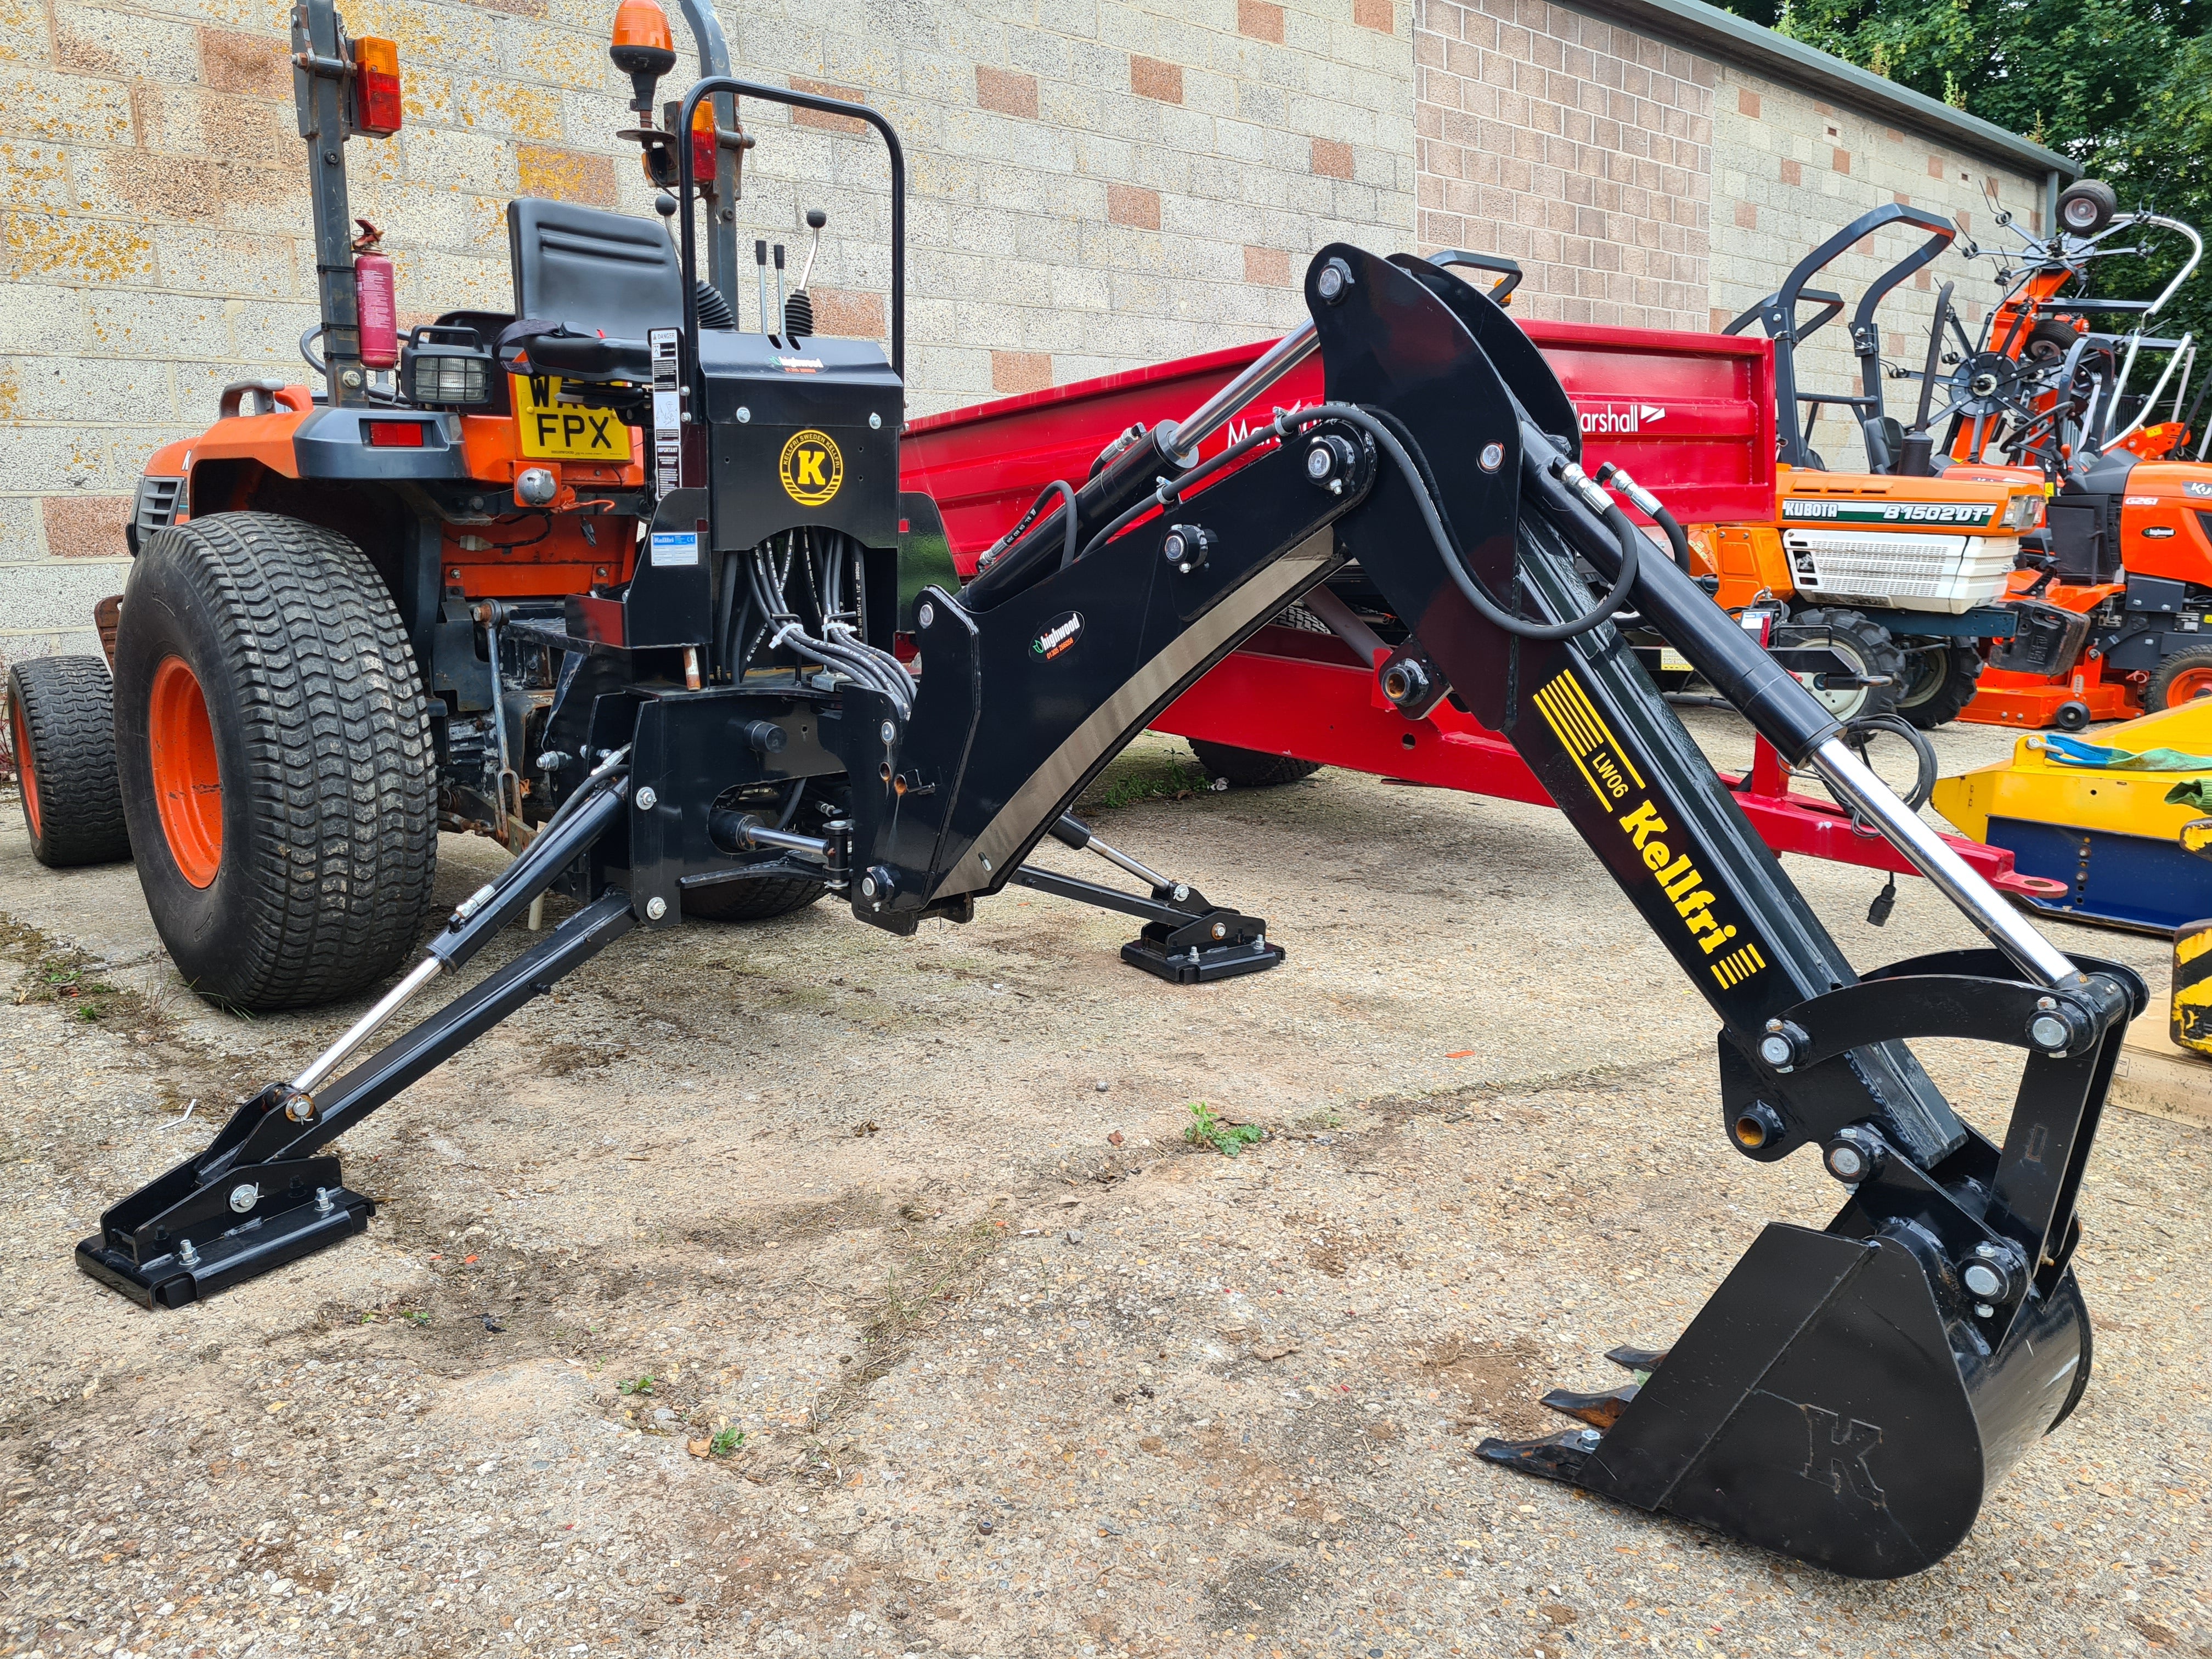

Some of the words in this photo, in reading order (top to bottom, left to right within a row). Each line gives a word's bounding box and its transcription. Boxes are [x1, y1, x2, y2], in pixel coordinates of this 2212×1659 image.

[537, 413, 612, 449] FPX
[1573, 403, 1639, 432] arshall
[783, 439, 799, 465] KELLFRI
[799, 433, 826, 442] SWEDEN
[826, 441, 840, 469] KELLFRI
[798, 450, 826, 486] K
[2125, 496, 2159, 505] G261
[2191, 483, 2212, 495] Ku
[1785, 503, 1838, 518] KUBOTA
[1883, 505, 1989, 522] B1502DT
[1040, 613, 1081, 651] highwood
[1046, 647, 1059, 659] 01305
[1592, 751, 1630, 799] LW06
[1618, 799, 1738, 955] Kellfri
